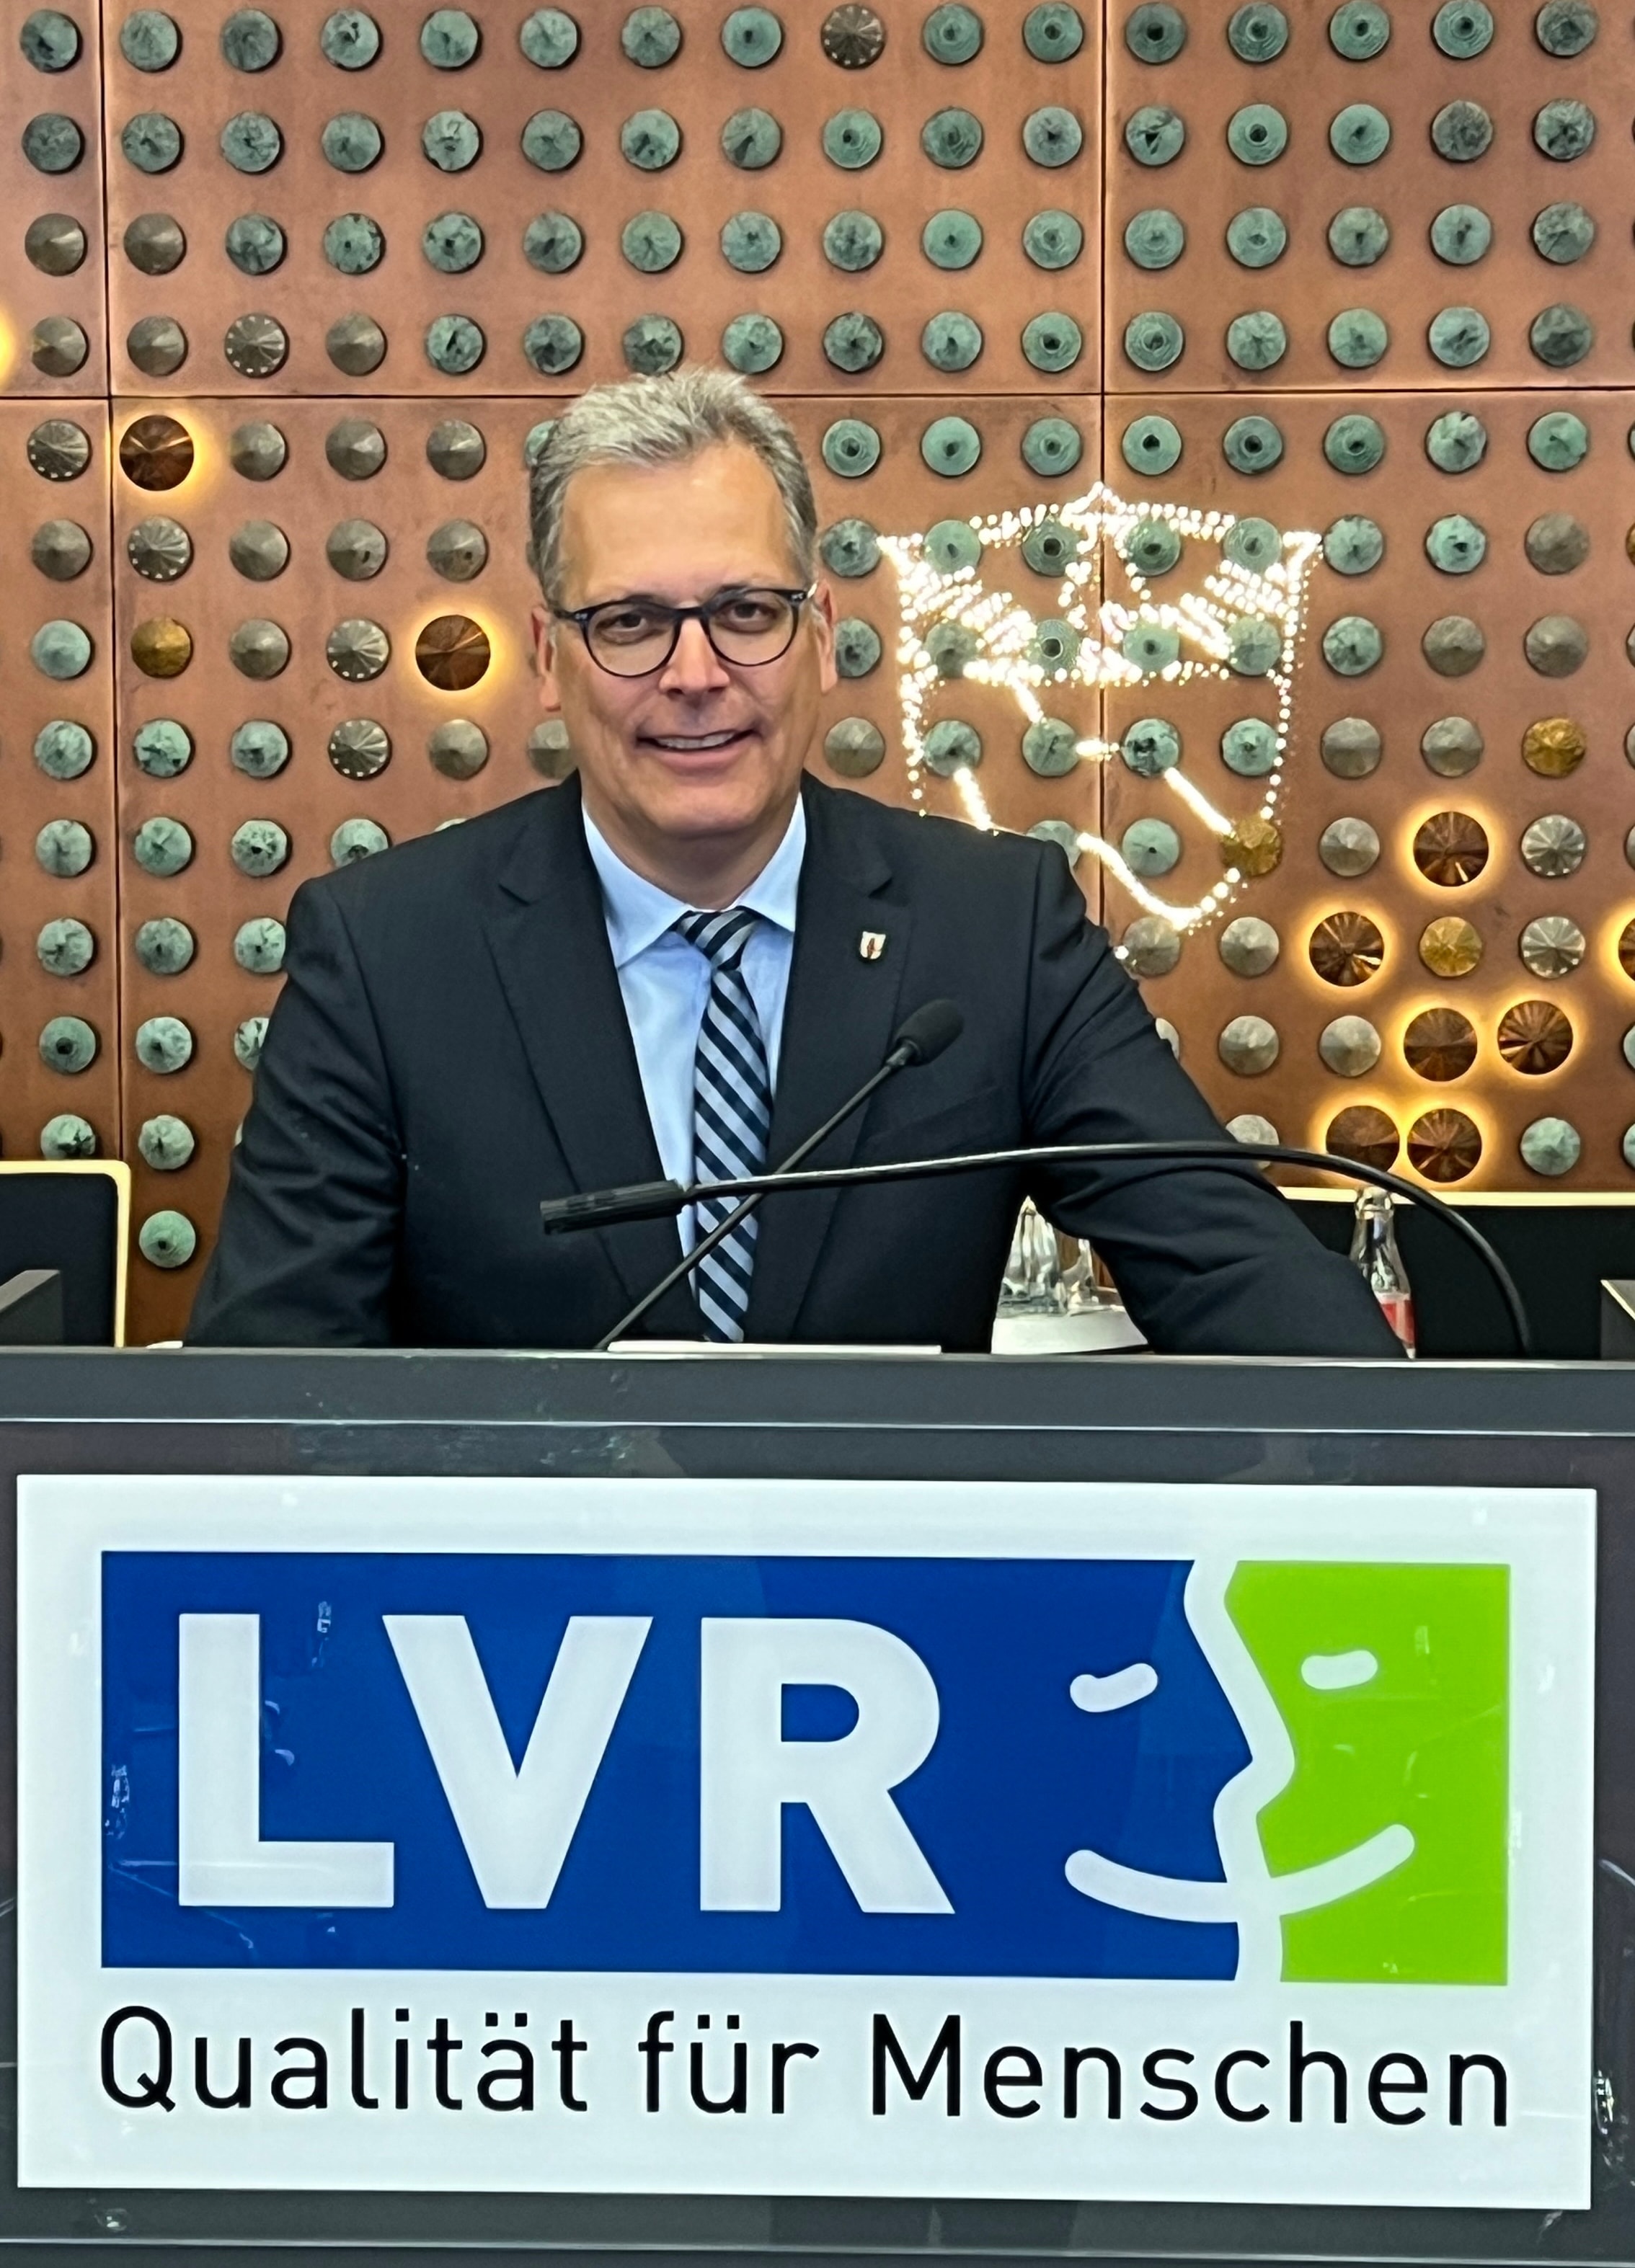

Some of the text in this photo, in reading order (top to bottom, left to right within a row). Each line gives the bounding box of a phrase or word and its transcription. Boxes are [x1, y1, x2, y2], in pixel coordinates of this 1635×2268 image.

[177, 1612, 956, 1915] LVR
[100, 2005, 1507, 2128] Qualität für Menschen
